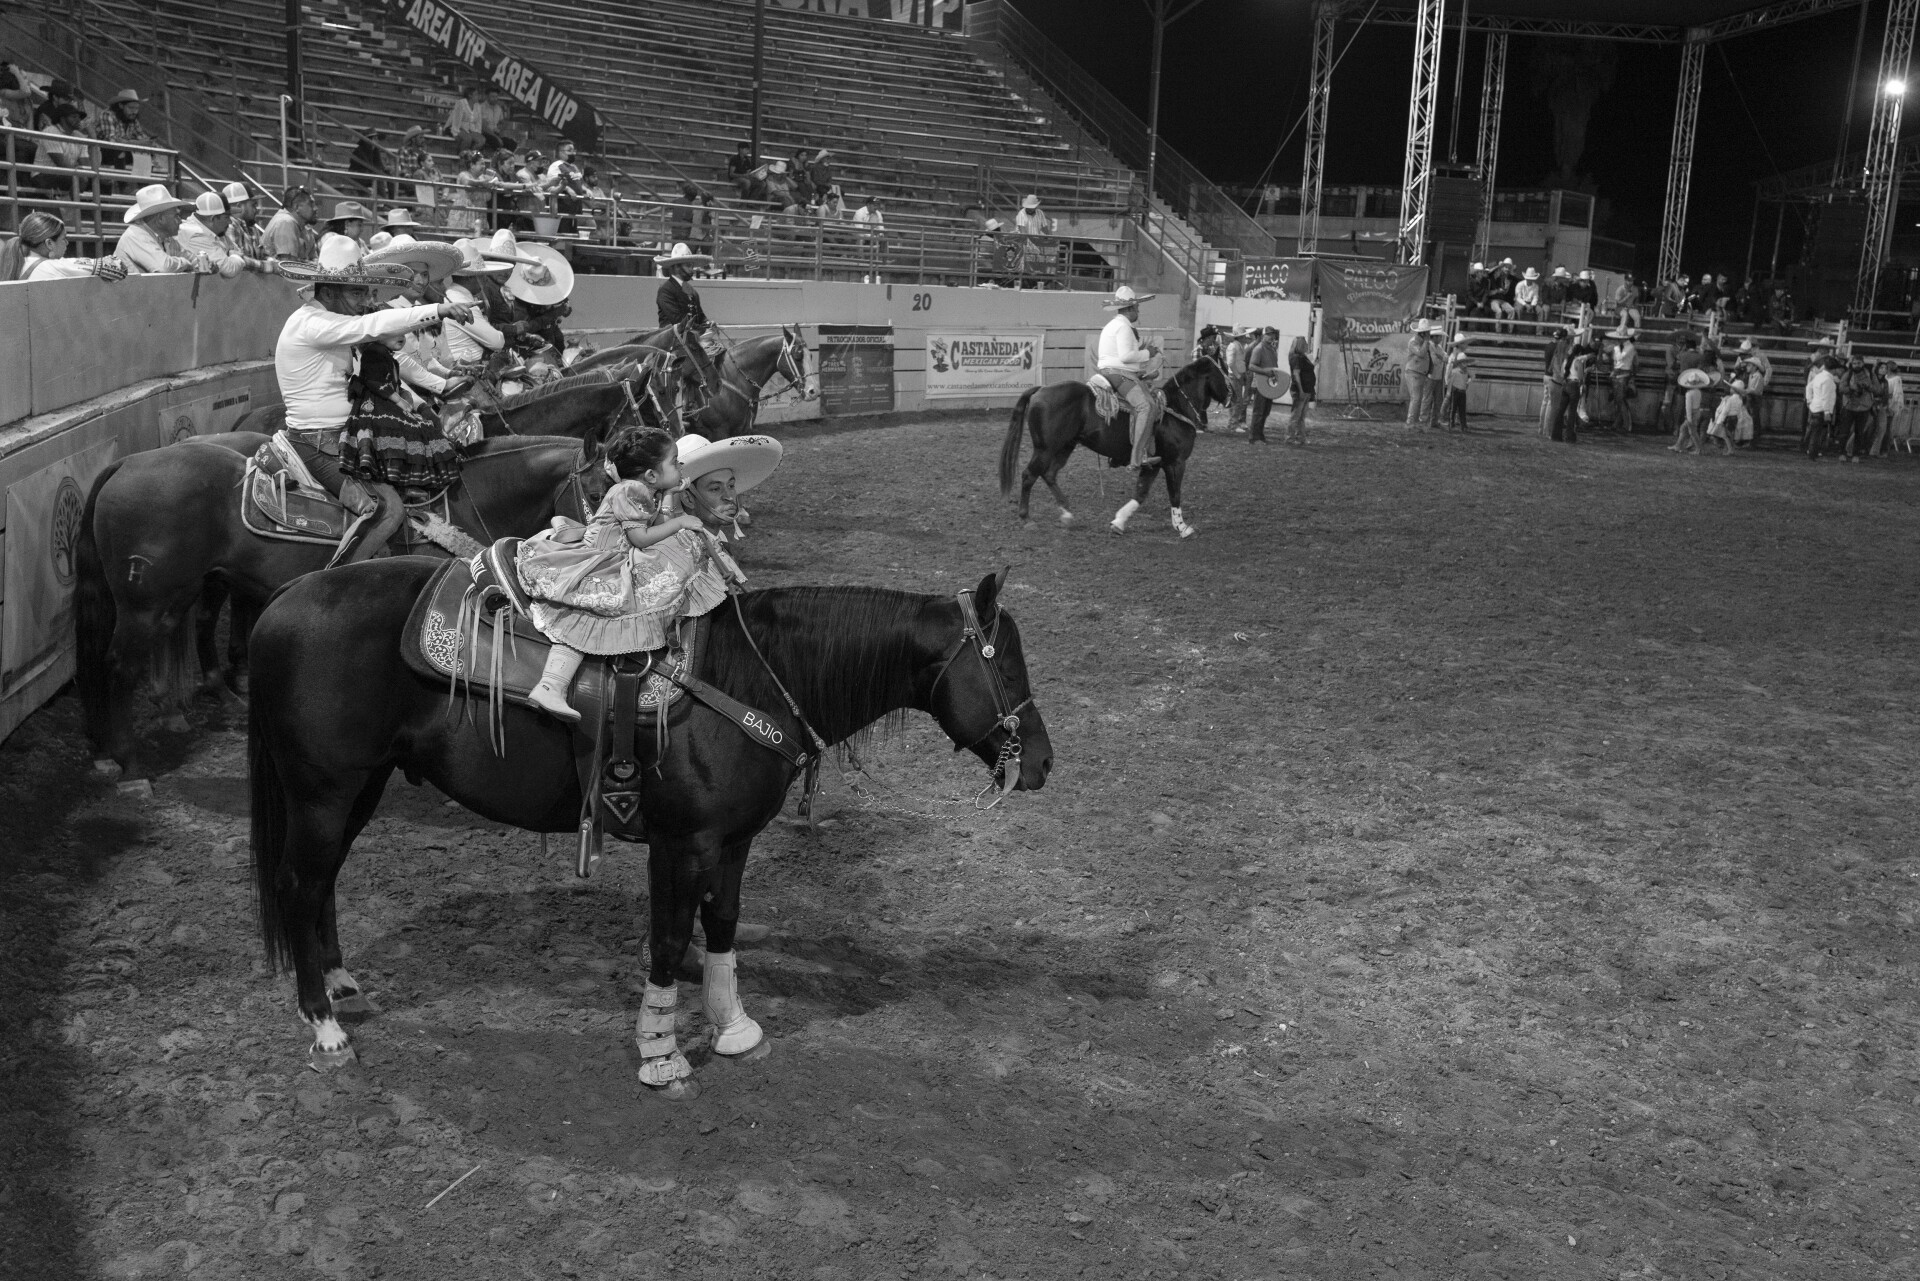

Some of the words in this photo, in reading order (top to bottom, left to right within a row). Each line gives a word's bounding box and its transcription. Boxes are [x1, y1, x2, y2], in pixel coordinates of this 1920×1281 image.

[406, 0, 454, 48] AREA
[455, 21, 487, 66] VIP
[491, 56, 543, 111] AREA
[543, 86, 578, 130] VIP
[1245, 264, 1289, 284] PALCO
[1344, 268, 1398, 290] PALCO
[912, 293, 932, 311] 20
[1371, 369, 1401, 385] COSAS
[742, 711, 783, 744] BAJIO
